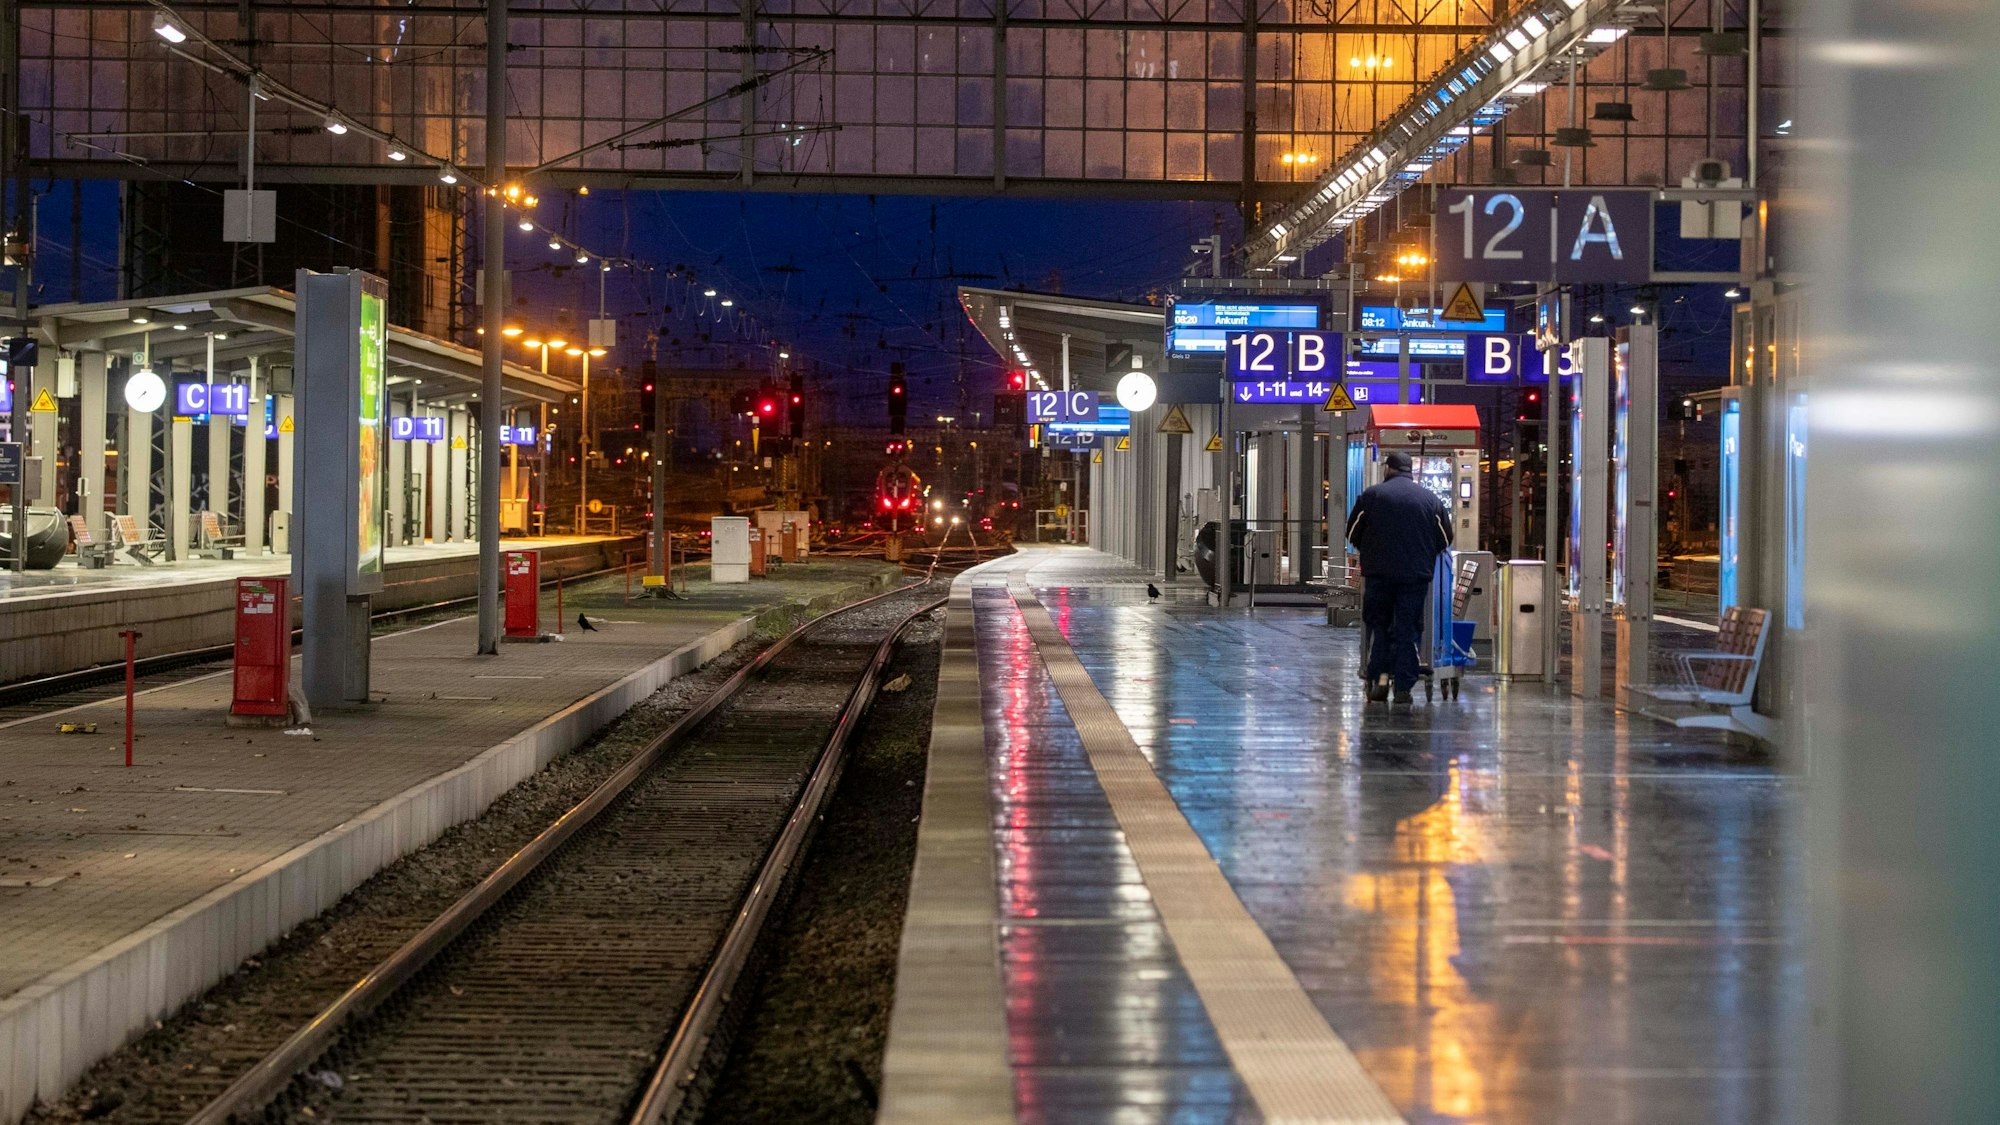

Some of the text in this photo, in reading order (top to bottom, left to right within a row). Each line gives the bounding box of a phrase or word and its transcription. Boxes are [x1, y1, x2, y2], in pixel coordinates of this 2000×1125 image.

[1448, 193, 1624, 260] 12 A
[1174, 315, 1198, 325] 08:20
[1214, 315, 1248, 326] Ankunft
[1361, 318, 1386, 328] 08:12
[1402, 318, 1436, 328] Ankunt
[1231, 333, 1326, 372] 12 B
[1484, 336, 1512, 375] B
[186, 383, 243, 410] C 11
[1256, 381, 1287, 397] 1-11
[1289, 388, 1303, 397] und
[1030, 391, 1090, 416] 12 C
[397, 417, 440, 436] D 11
[500, 425, 533, 442] E 11
